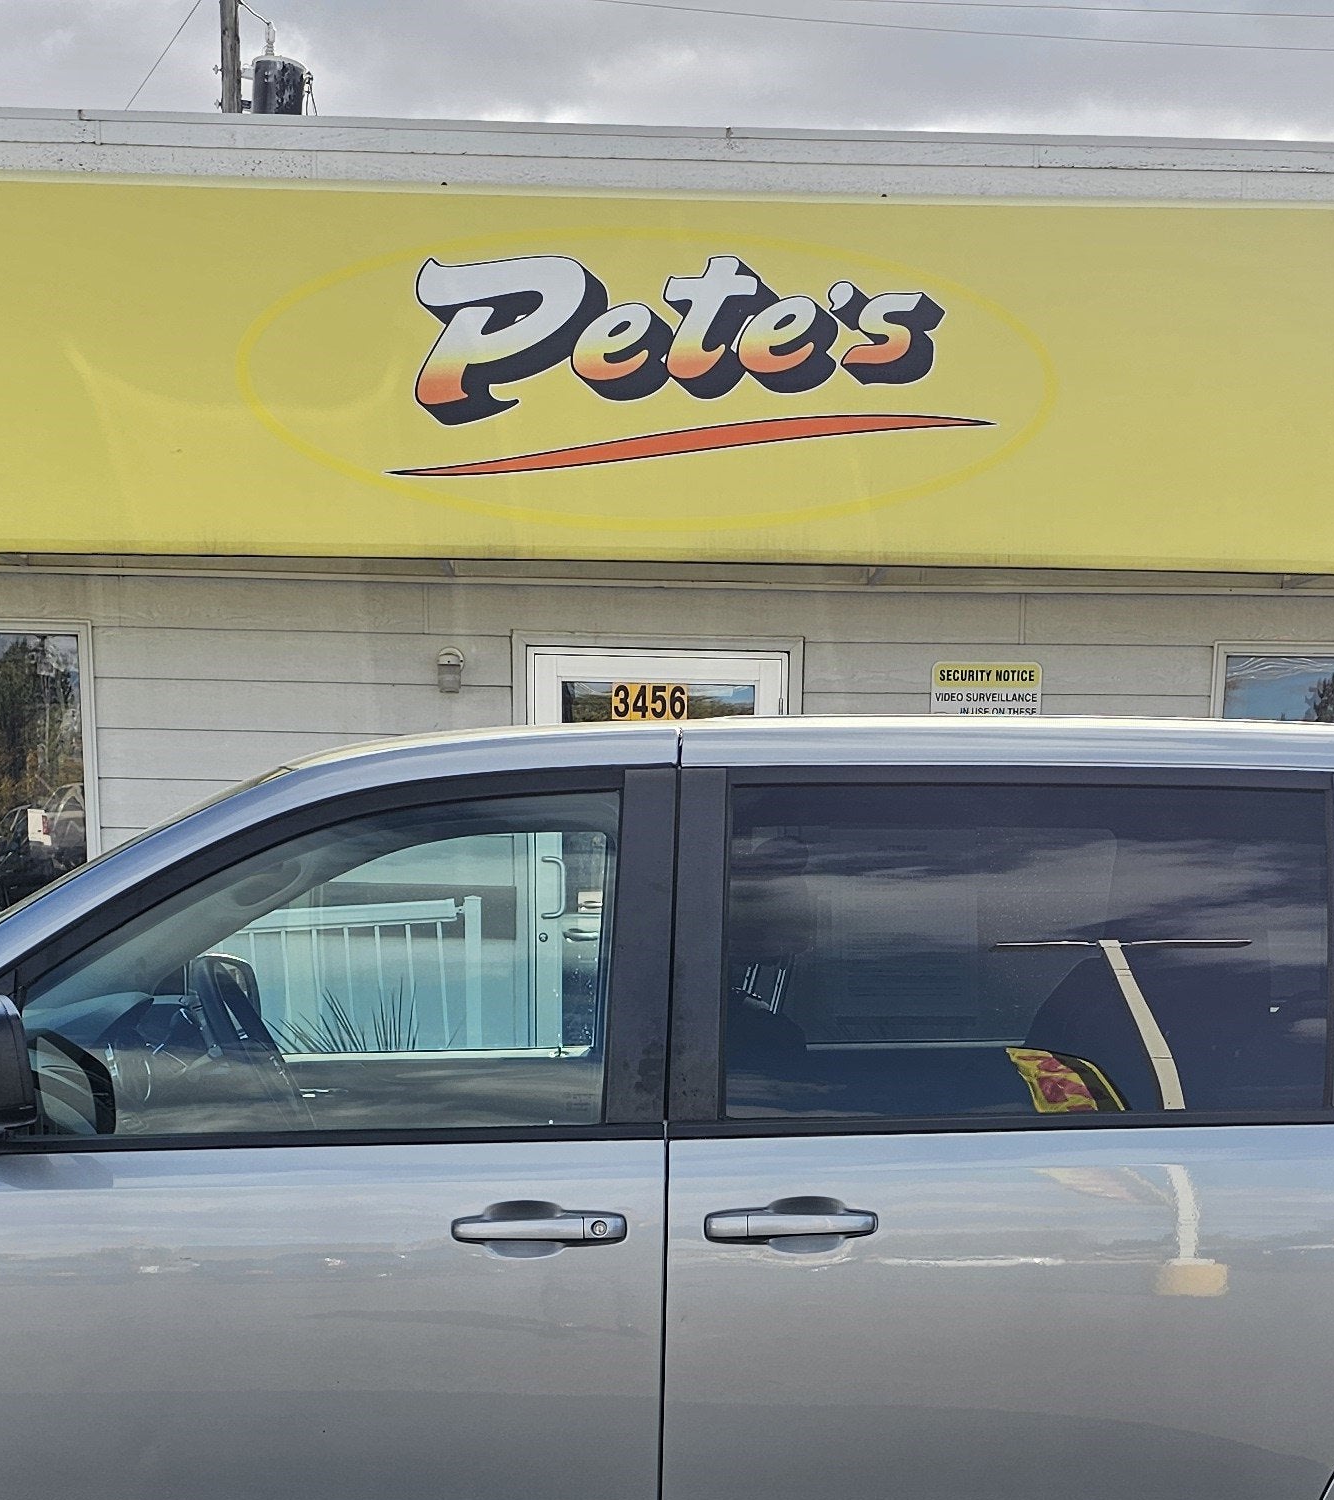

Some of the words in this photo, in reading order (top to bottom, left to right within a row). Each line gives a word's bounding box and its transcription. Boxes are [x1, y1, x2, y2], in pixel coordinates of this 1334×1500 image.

[416, 255, 944, 425] Pete's
[939, 669, 992, 682] SECURITY
[995, 669, 1035, 682] NOTICE
[613, 684, 686, 719] 3456
[935, 692, 964, 702] VIDEO
[965, 692, 1038, 703] SURVEILLANCE
